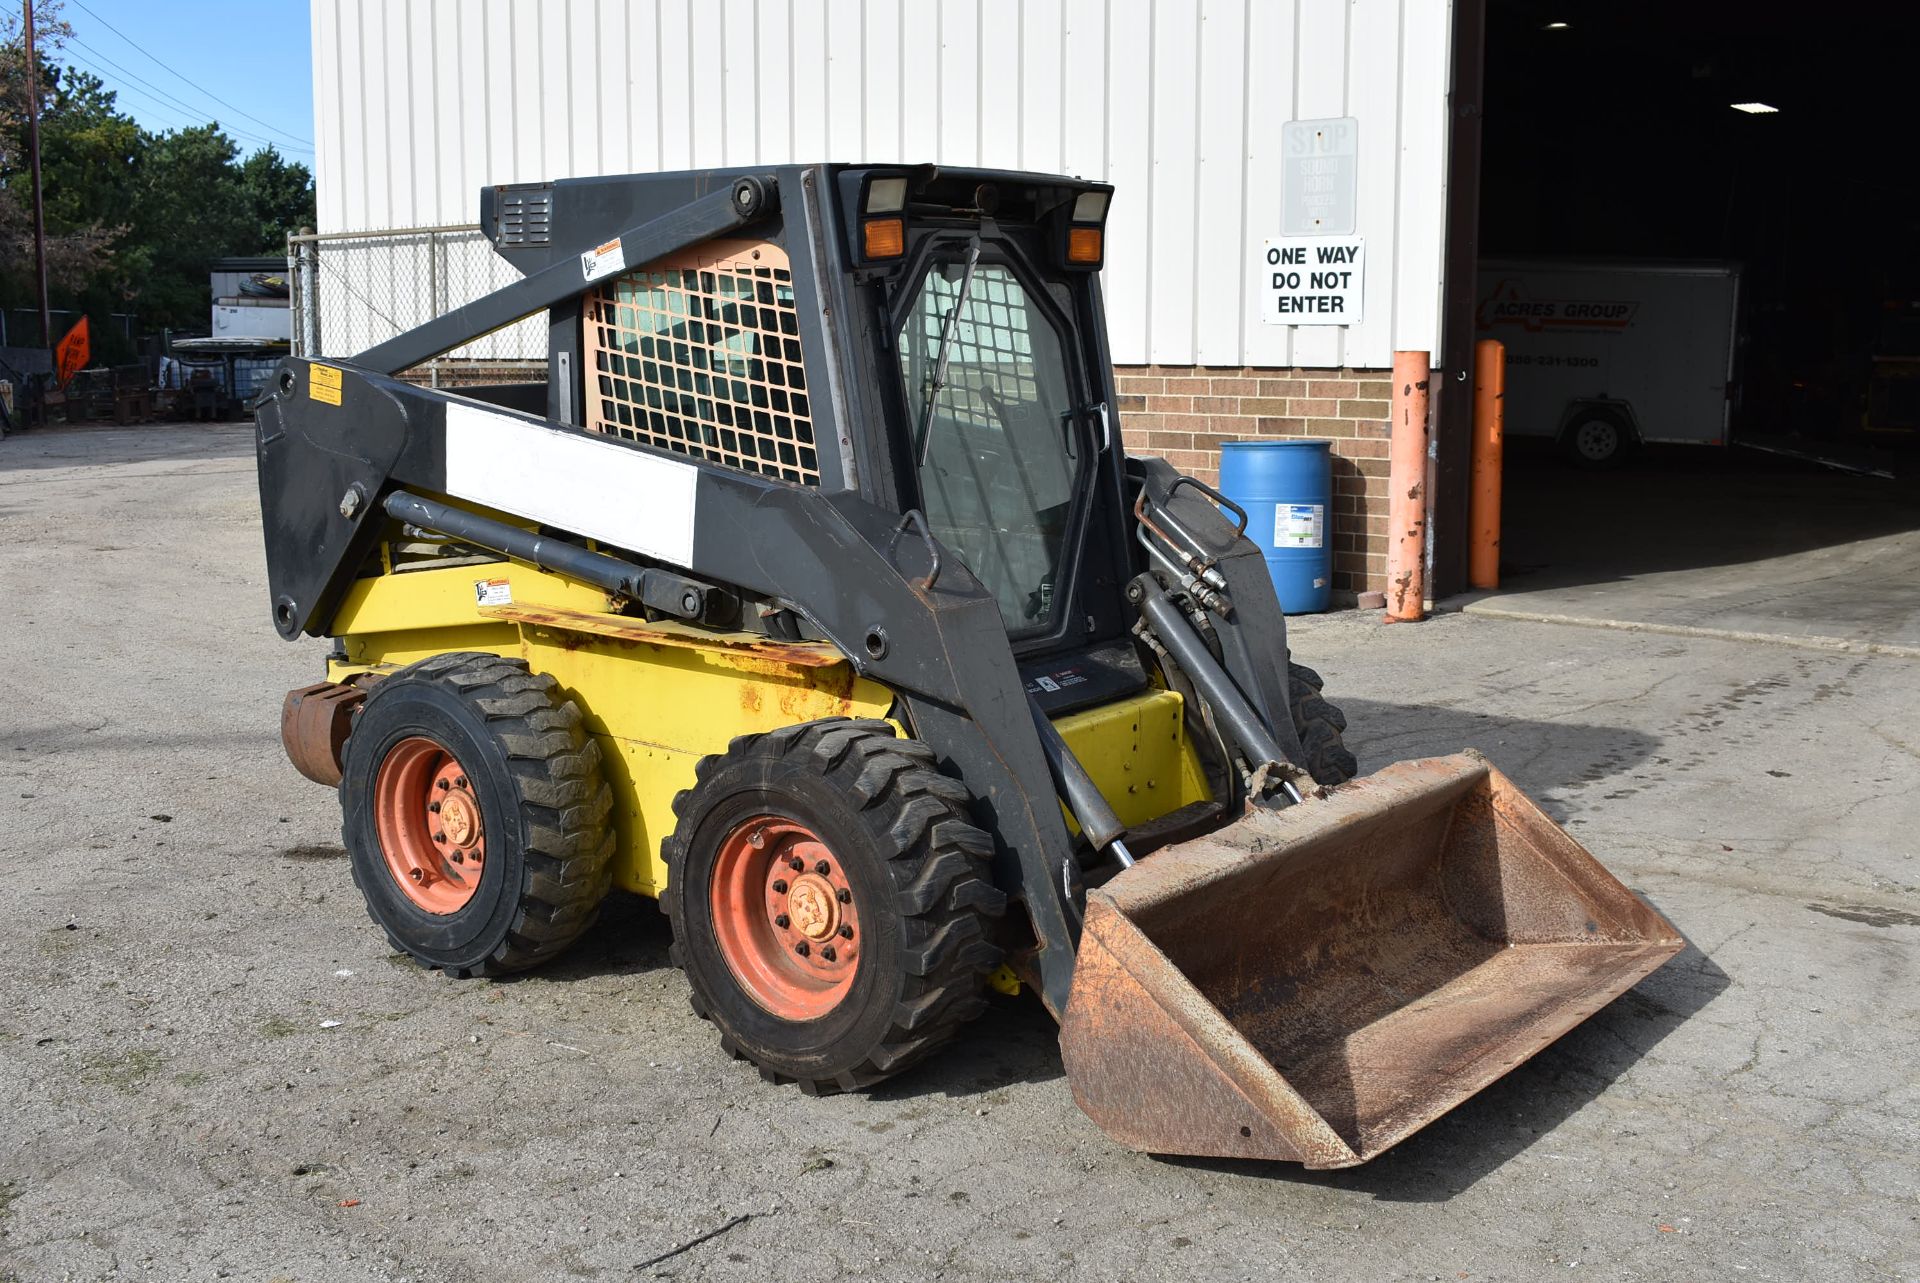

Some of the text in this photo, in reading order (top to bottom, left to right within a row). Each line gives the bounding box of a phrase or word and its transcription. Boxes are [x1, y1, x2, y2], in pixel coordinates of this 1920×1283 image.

[1291, 125, 1347, 155] STOP
[1303, 175, 1335, 193] HORN
[1267, 246, 1359, 265] ONE WAY
[1273, 271, 1352, 289] DO NOT
[1278, 295, 1344, 313] ENTER
[1493, 302, 1629, 319] ACRES GROUP
